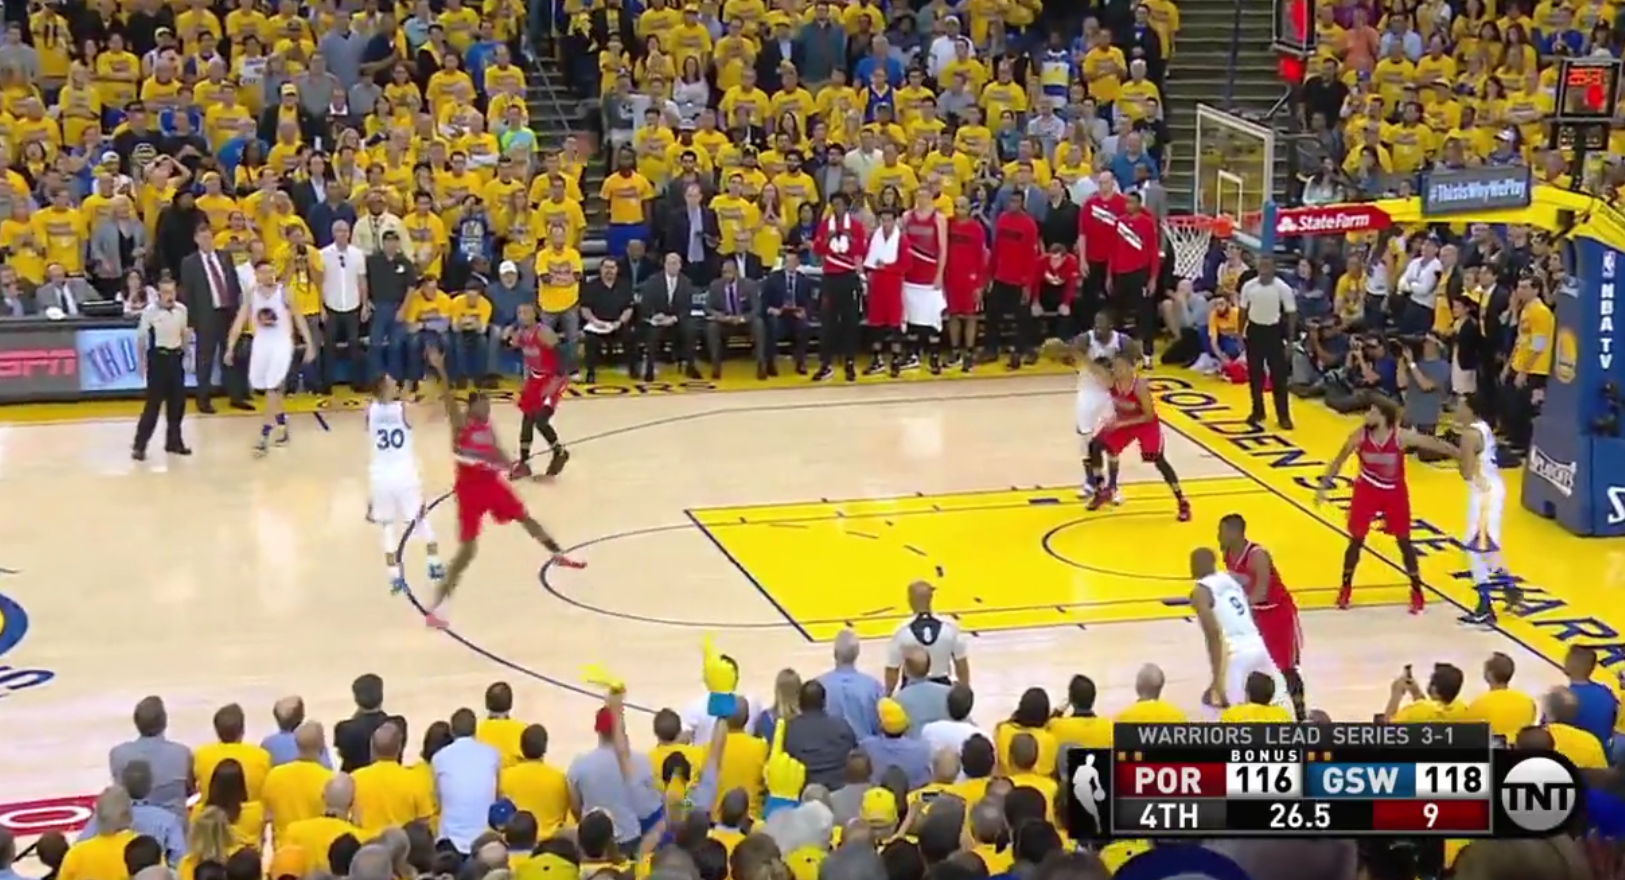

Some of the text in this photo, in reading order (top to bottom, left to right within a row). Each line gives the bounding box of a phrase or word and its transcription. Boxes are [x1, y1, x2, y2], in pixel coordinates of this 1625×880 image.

[1600, 283, 1614, 369] NBA TV
[376, 429, 405, 449] 30
[1229, 596, 1245, 616] 9
